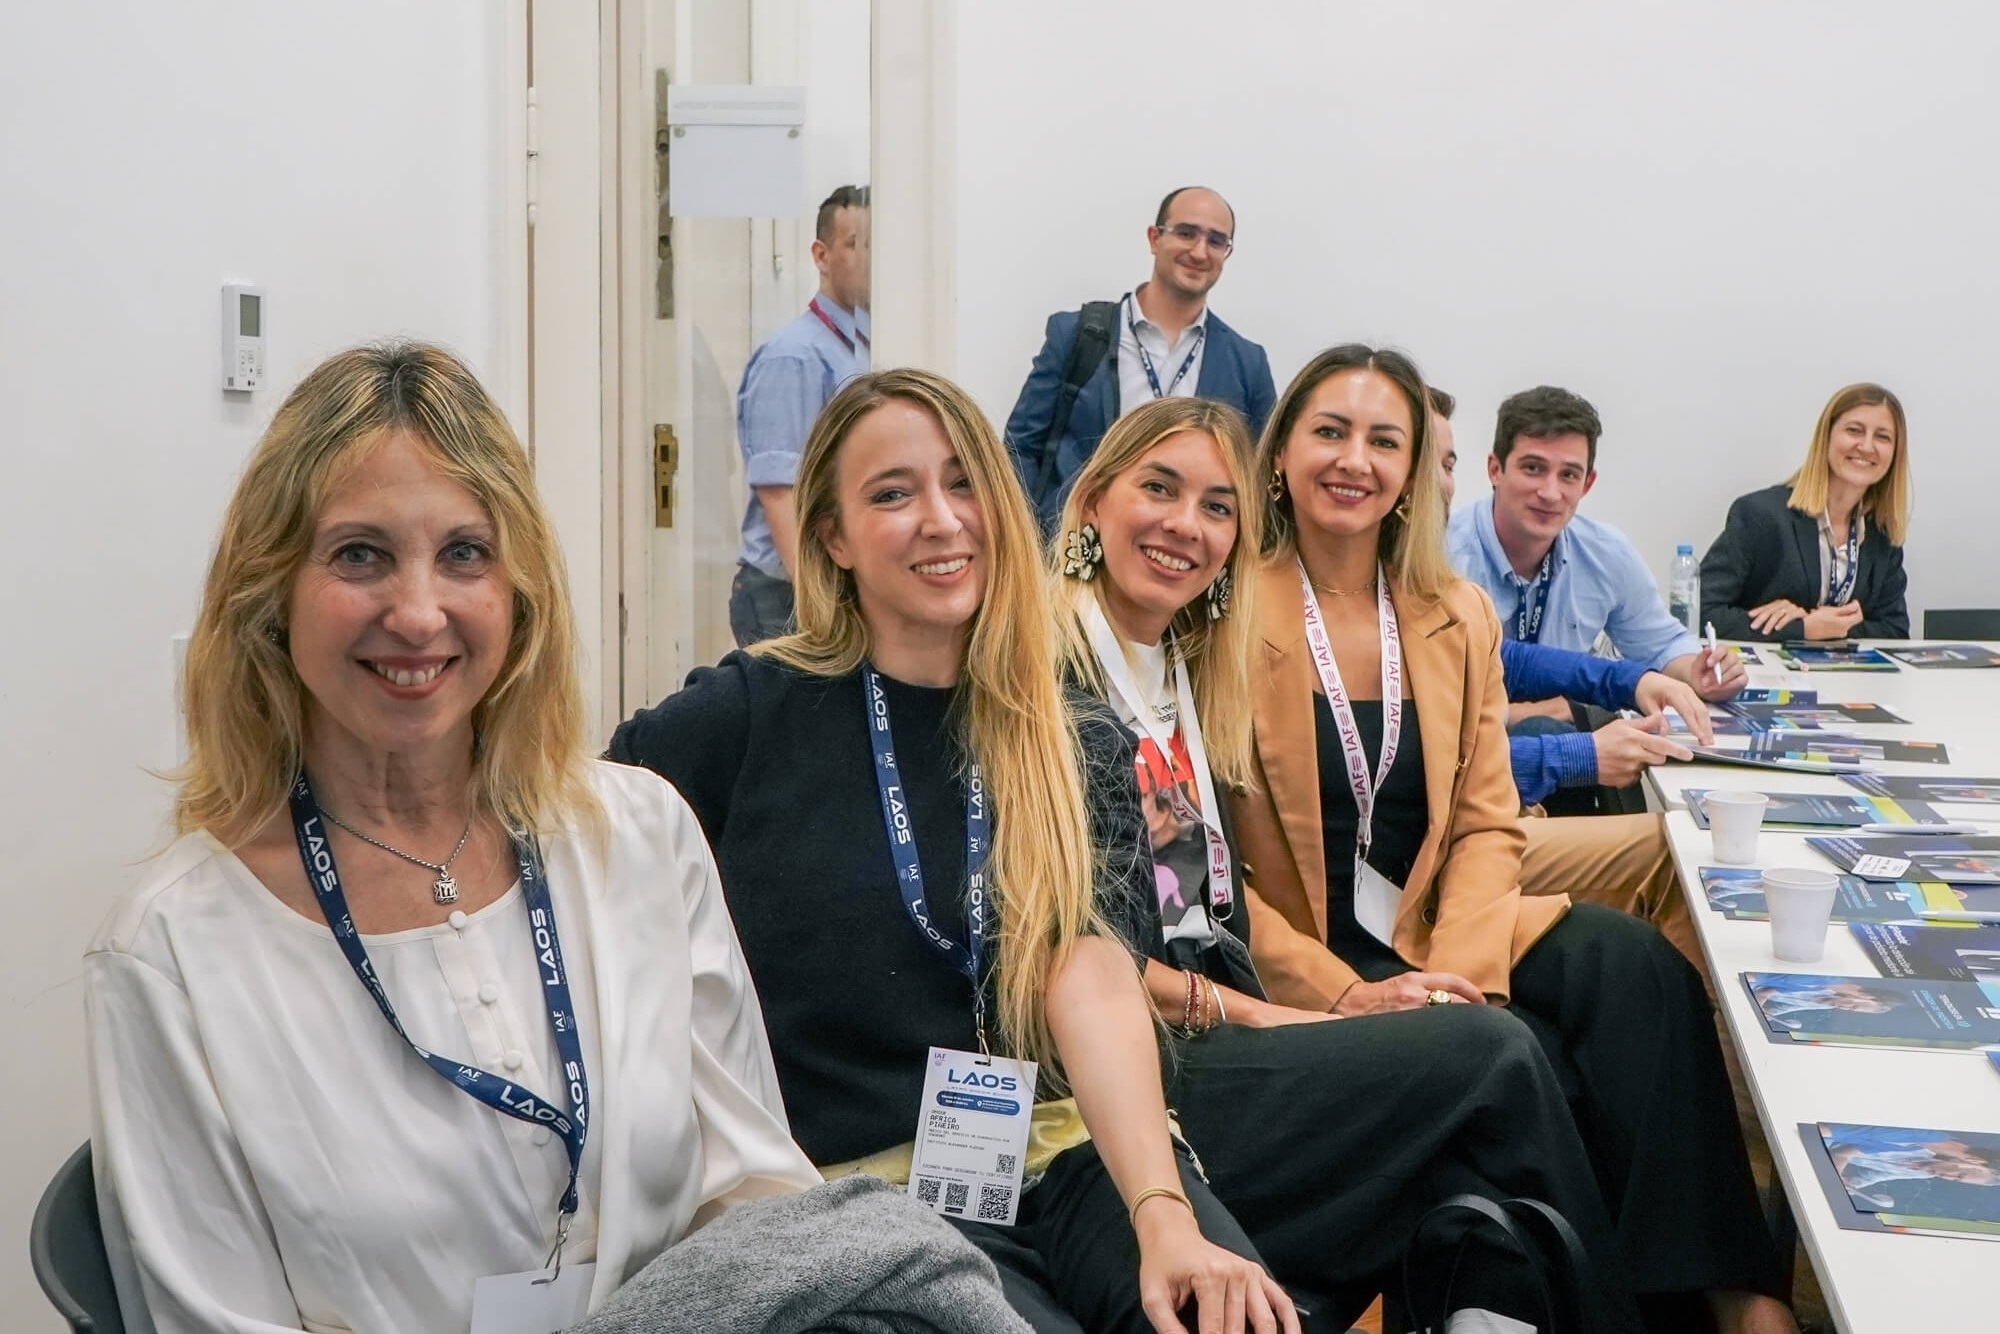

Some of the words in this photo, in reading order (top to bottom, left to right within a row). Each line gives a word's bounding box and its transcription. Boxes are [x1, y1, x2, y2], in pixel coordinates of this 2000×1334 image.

[1315, 644, 1331, 666] IAF
[1389, 661, 1399, 684] IAF
[871, 673, 889, 731] LAOS
[1329, 685, 1344, 708] IAF
[1390, 702, 1399, 726] IAF
[1342, 728, 1358, 752] IAF
[971, 764, 983, 820] LAOS
[1352, 772, 1366, 795] IAF
[888, 786, 911, 845] LAOS
[304, 817, 337, 892] LAOS
[971, 837, 979, 853] IAF
[521, 860, 533, 880] IAF
[908, 864, 920, 881] IAF
[971, 873, 983, 935] LAOS
[342, 913, 354, 936] IAF
[912, 899, 953, 950] LAOS
[531, 908, 559, 985] LAOS
[553, 1010, 565, 1032] IAF
[458, 1066, 482, 1079] IAF
[948, 1069, 1017, 1091] LAOS
[500, 1085, 572, 1134] LAOS
[565, 1060, 585, 1144] LAOS
